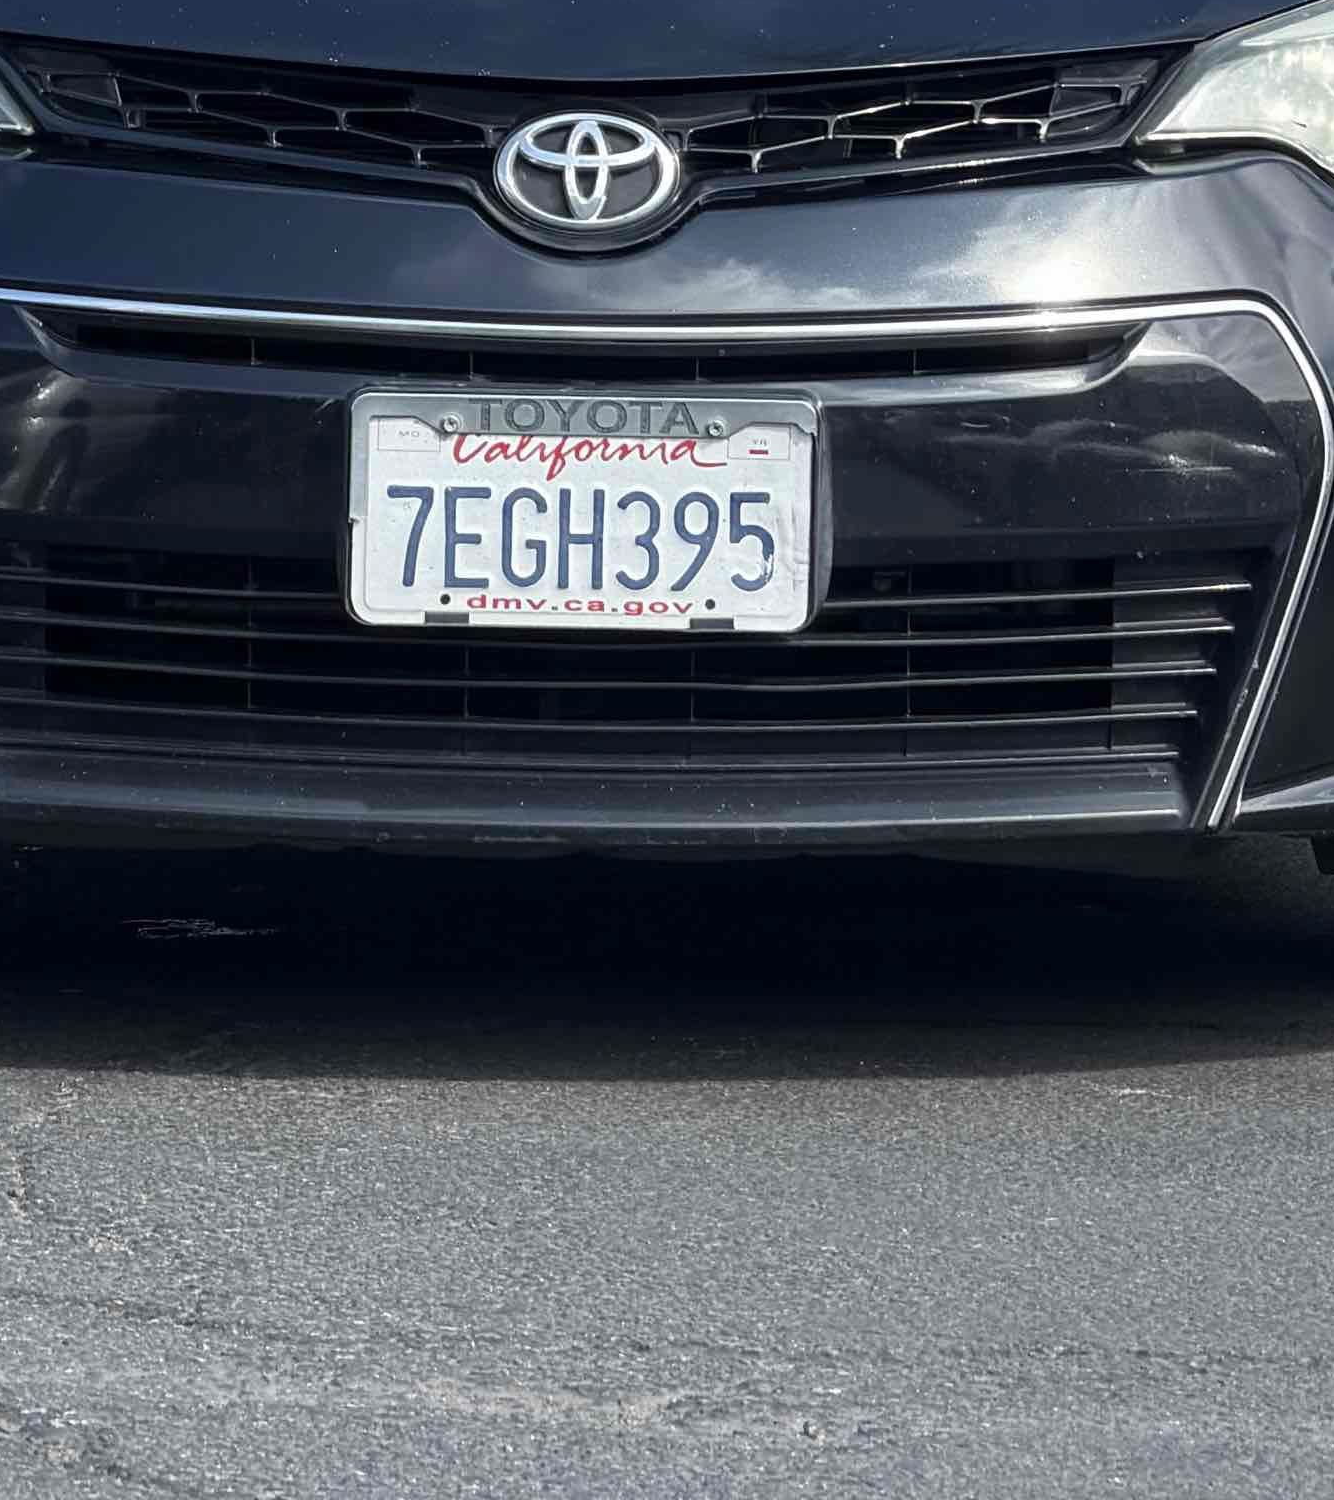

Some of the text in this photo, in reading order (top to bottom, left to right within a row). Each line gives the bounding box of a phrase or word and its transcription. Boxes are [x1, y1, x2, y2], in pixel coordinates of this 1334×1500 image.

[469, 400, 700, 435] TOYOTA
[452, 434, 727, 482] California
[387, 485, 776, 592] 7EGH395
[466, 593, 694, 617] dmv.ca.gov
